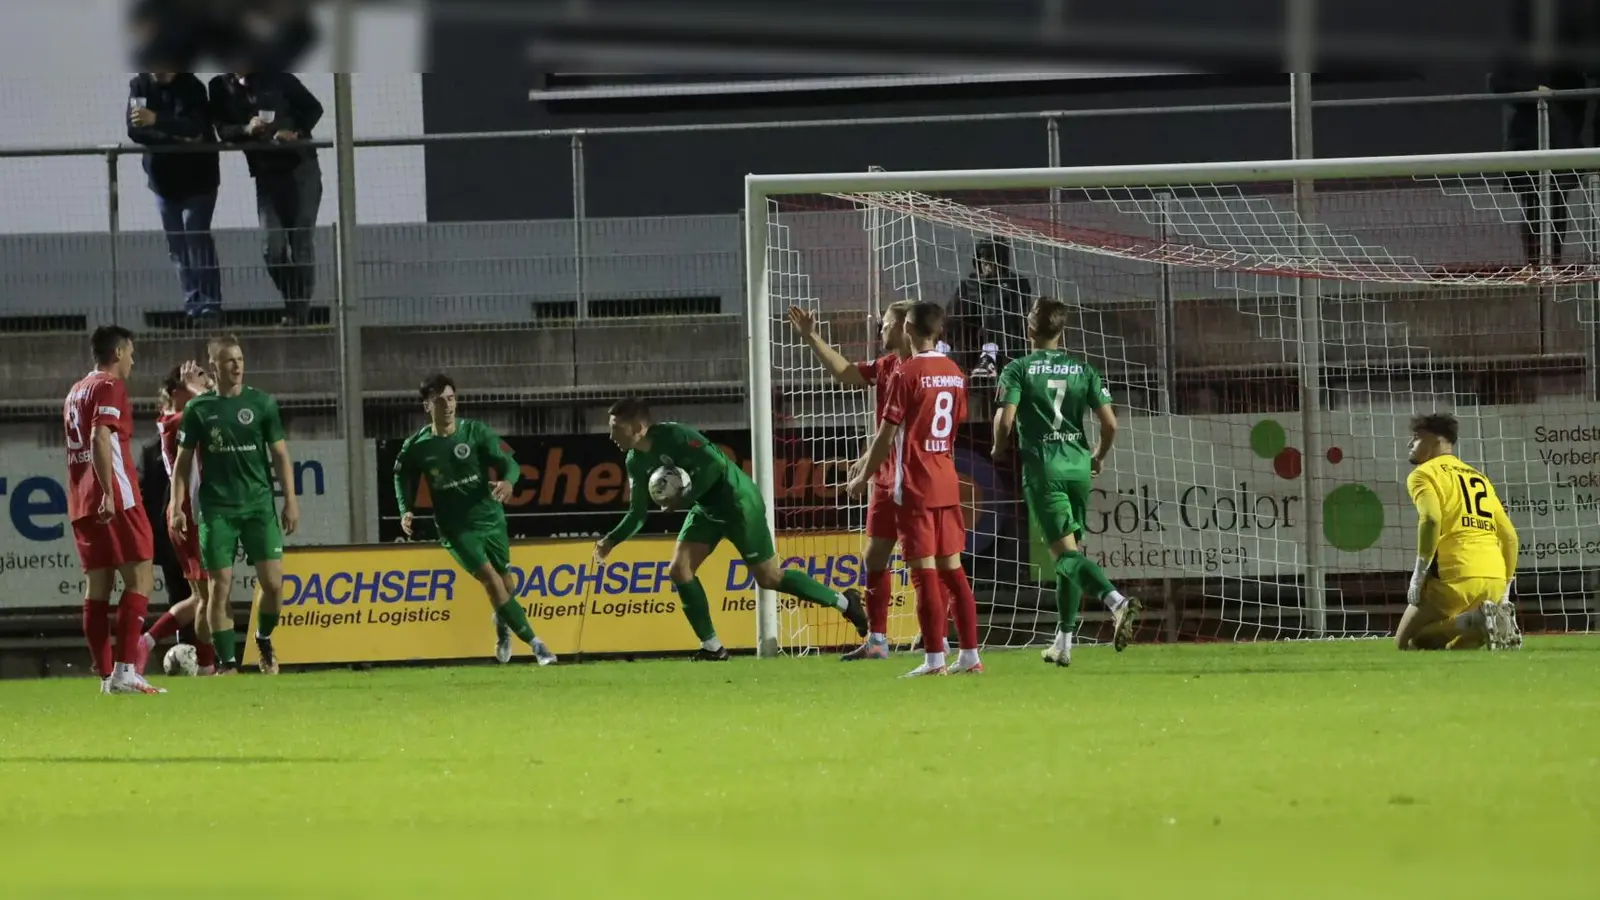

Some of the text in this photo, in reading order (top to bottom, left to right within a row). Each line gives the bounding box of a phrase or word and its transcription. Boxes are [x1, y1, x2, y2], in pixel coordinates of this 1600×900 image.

[931, 391, 953, 438] 8
[1047, 379, 1067, 430] 7
[1083, 481, 1298, 534] Gök Color
[1458, 474, 1493, 518] 12
[1555, 499, 1570, 512] u.
[282, 566, 456, 605] DACHSER
[280, 607, 450, 628] ntelligent Logistics
[592, 599, 676, 617] Logistics
